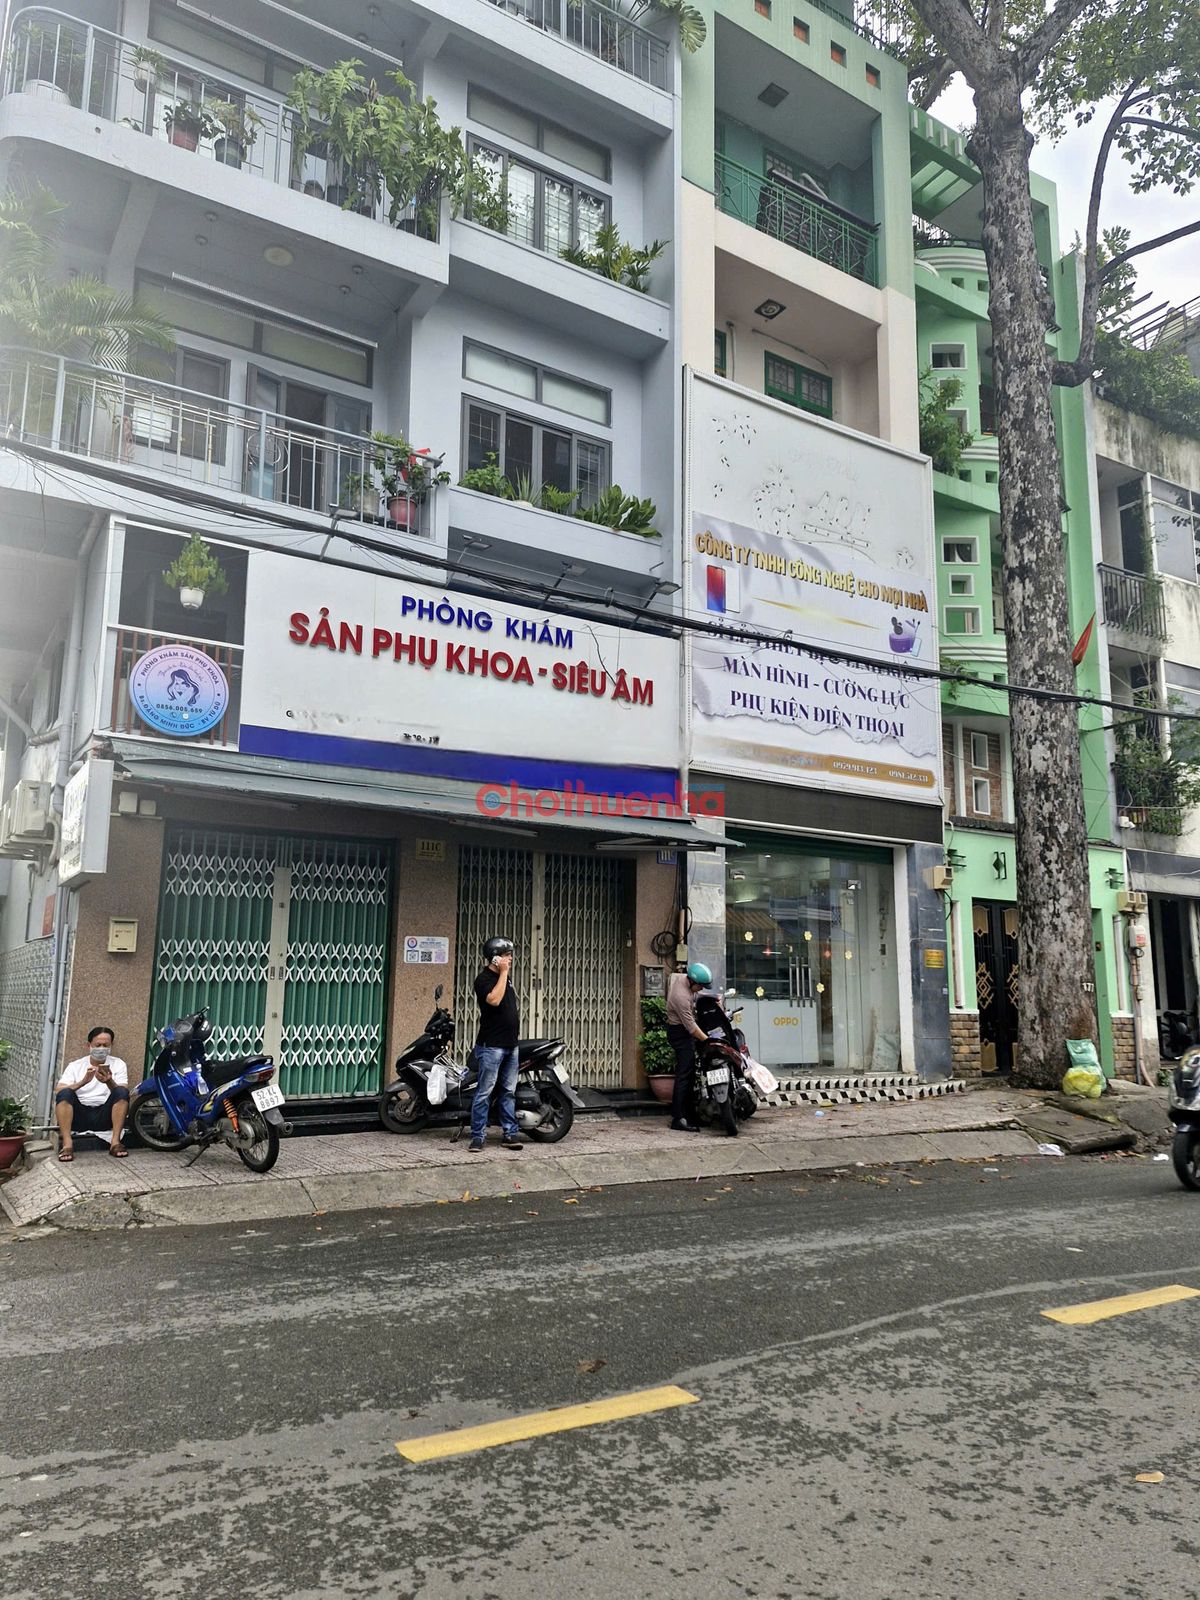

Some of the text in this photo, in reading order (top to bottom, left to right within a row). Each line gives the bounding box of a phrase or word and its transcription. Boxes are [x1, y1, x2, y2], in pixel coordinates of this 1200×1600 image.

[695, 530, 929, 613] CÔNG TY TNHH CÔNG NGHỆ CHO MỌI NHÀ
[401, 595, 574, 649] PHÒNG KHÁM
[140, 657, 158, 677] PHÒNG
[159, 651, 179, 660] KHÁM
[195, 657, 208, 668] PHỤ
[207, 667, 219, 685] KHOA
[289, 607, 363, 656] SẢN
[371, 628, 438, 670] PHỤ
[446, 642, 534, 686] KHOA
[552, 660, 607, 698] SIÊU
[611, 668, 654, 706] ÂM
[723, 656, 762, 679] MÀN
[766, 664, 809, 689] HÌNH
[823, 678, 878, 703] CƯỜNG
[881, 690, 910, 710] LỰC
[160, 719, 178, 729] MINH
[730, 690, 766, 715] PHỤ
[770, 696, 809, 721] KIỆN
[855, 714, 905, 739] THOẠI
[773, 1016, 799, 1026] OPPO
[260, 1095, 279, 1109] 8897
